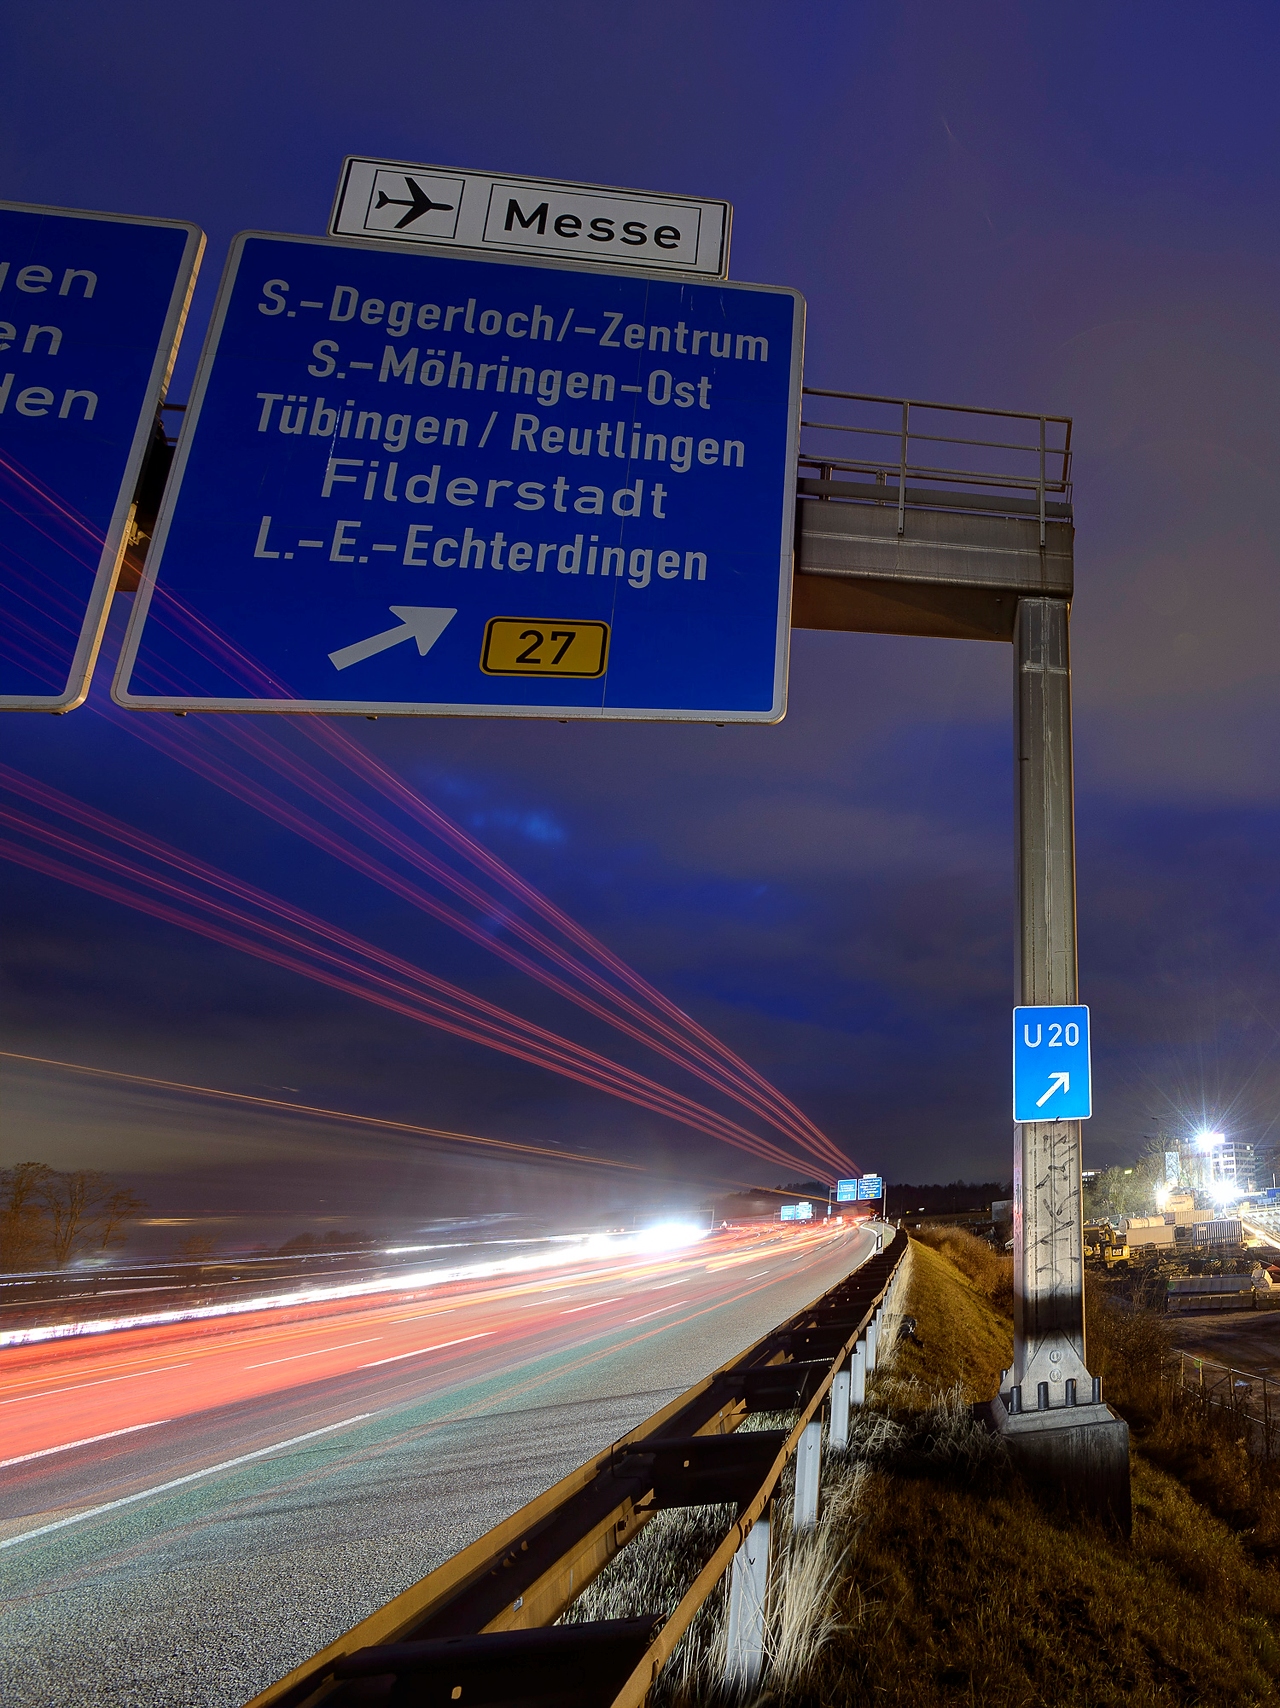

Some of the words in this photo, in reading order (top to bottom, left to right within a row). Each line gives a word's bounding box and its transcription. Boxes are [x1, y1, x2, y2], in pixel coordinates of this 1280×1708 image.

[504, 198, 683, 249] Messe
[257, 278, 770, 363] S.-Degerloch/-Zentrum
[307, 338, 712, 410] S.-Möhringen-Ost
[256, 392, 468, 453] Tübingen
[477, 410, 499, 449] /
[511, 412, 745, 474] Reutlingen
[320, 457, 668, 519] Filderstadt
[254, 515, 709, 589] L.-E.-Echterdingen
[514, 629, 577, 666] 27
